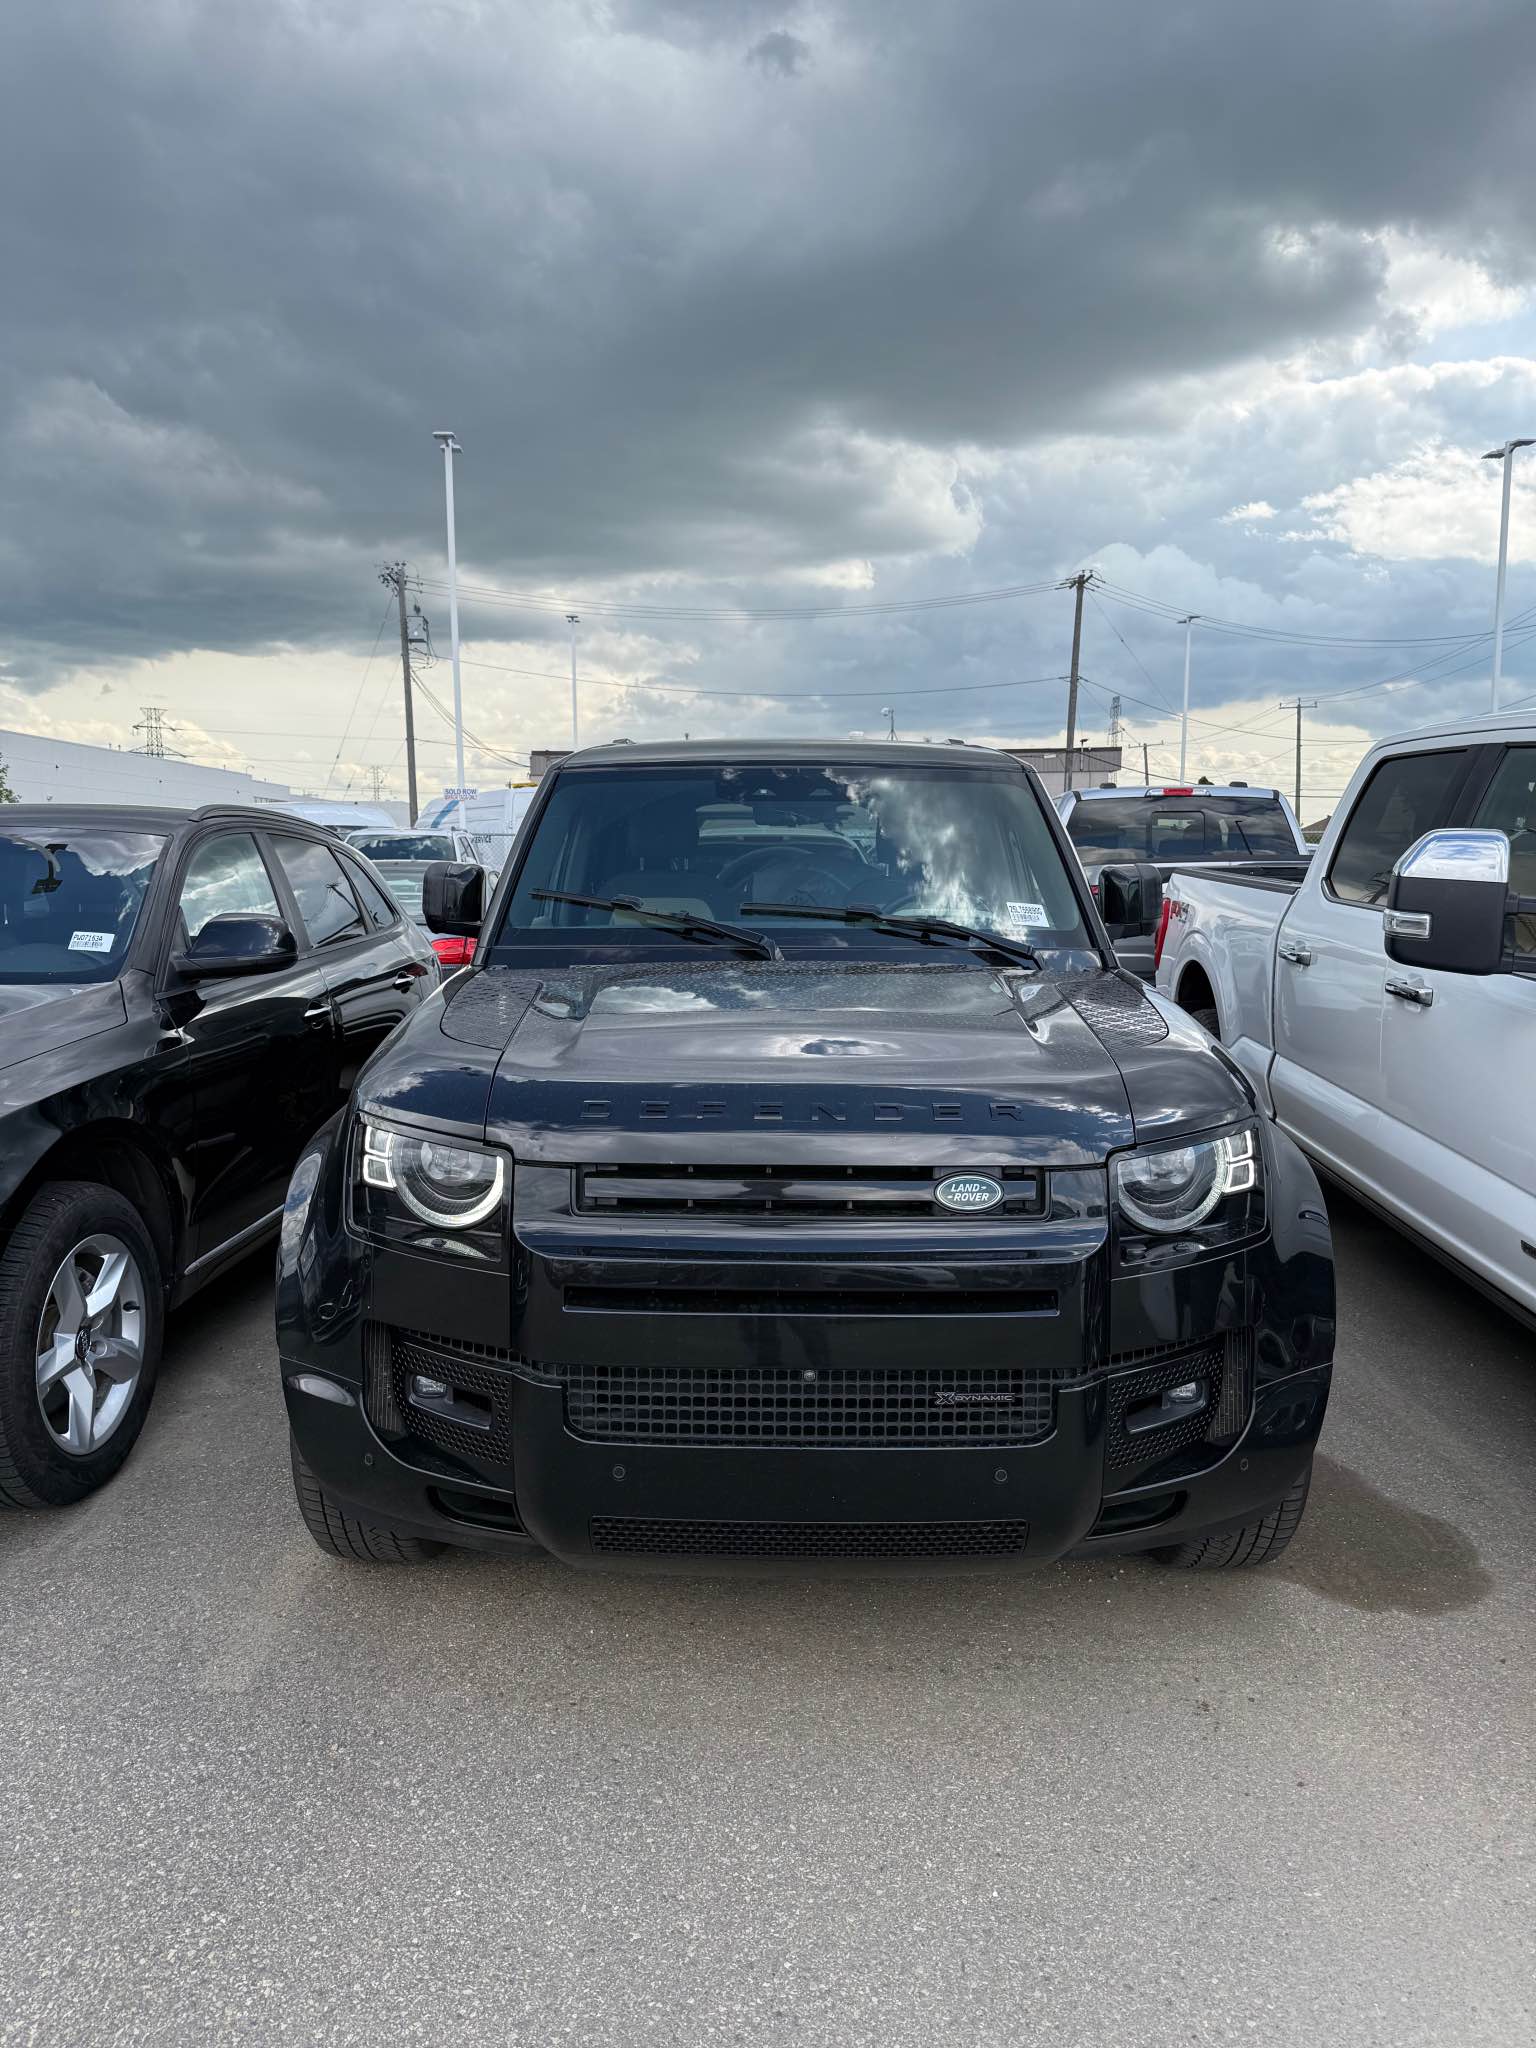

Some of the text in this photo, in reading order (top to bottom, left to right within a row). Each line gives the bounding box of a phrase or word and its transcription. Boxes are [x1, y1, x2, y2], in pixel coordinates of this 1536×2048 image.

[580, 1100, 1024, 1122] DEFENDER
[951, 1183, 980, 1193] LAND
[953, 1192, 990, 1202] ROVER
